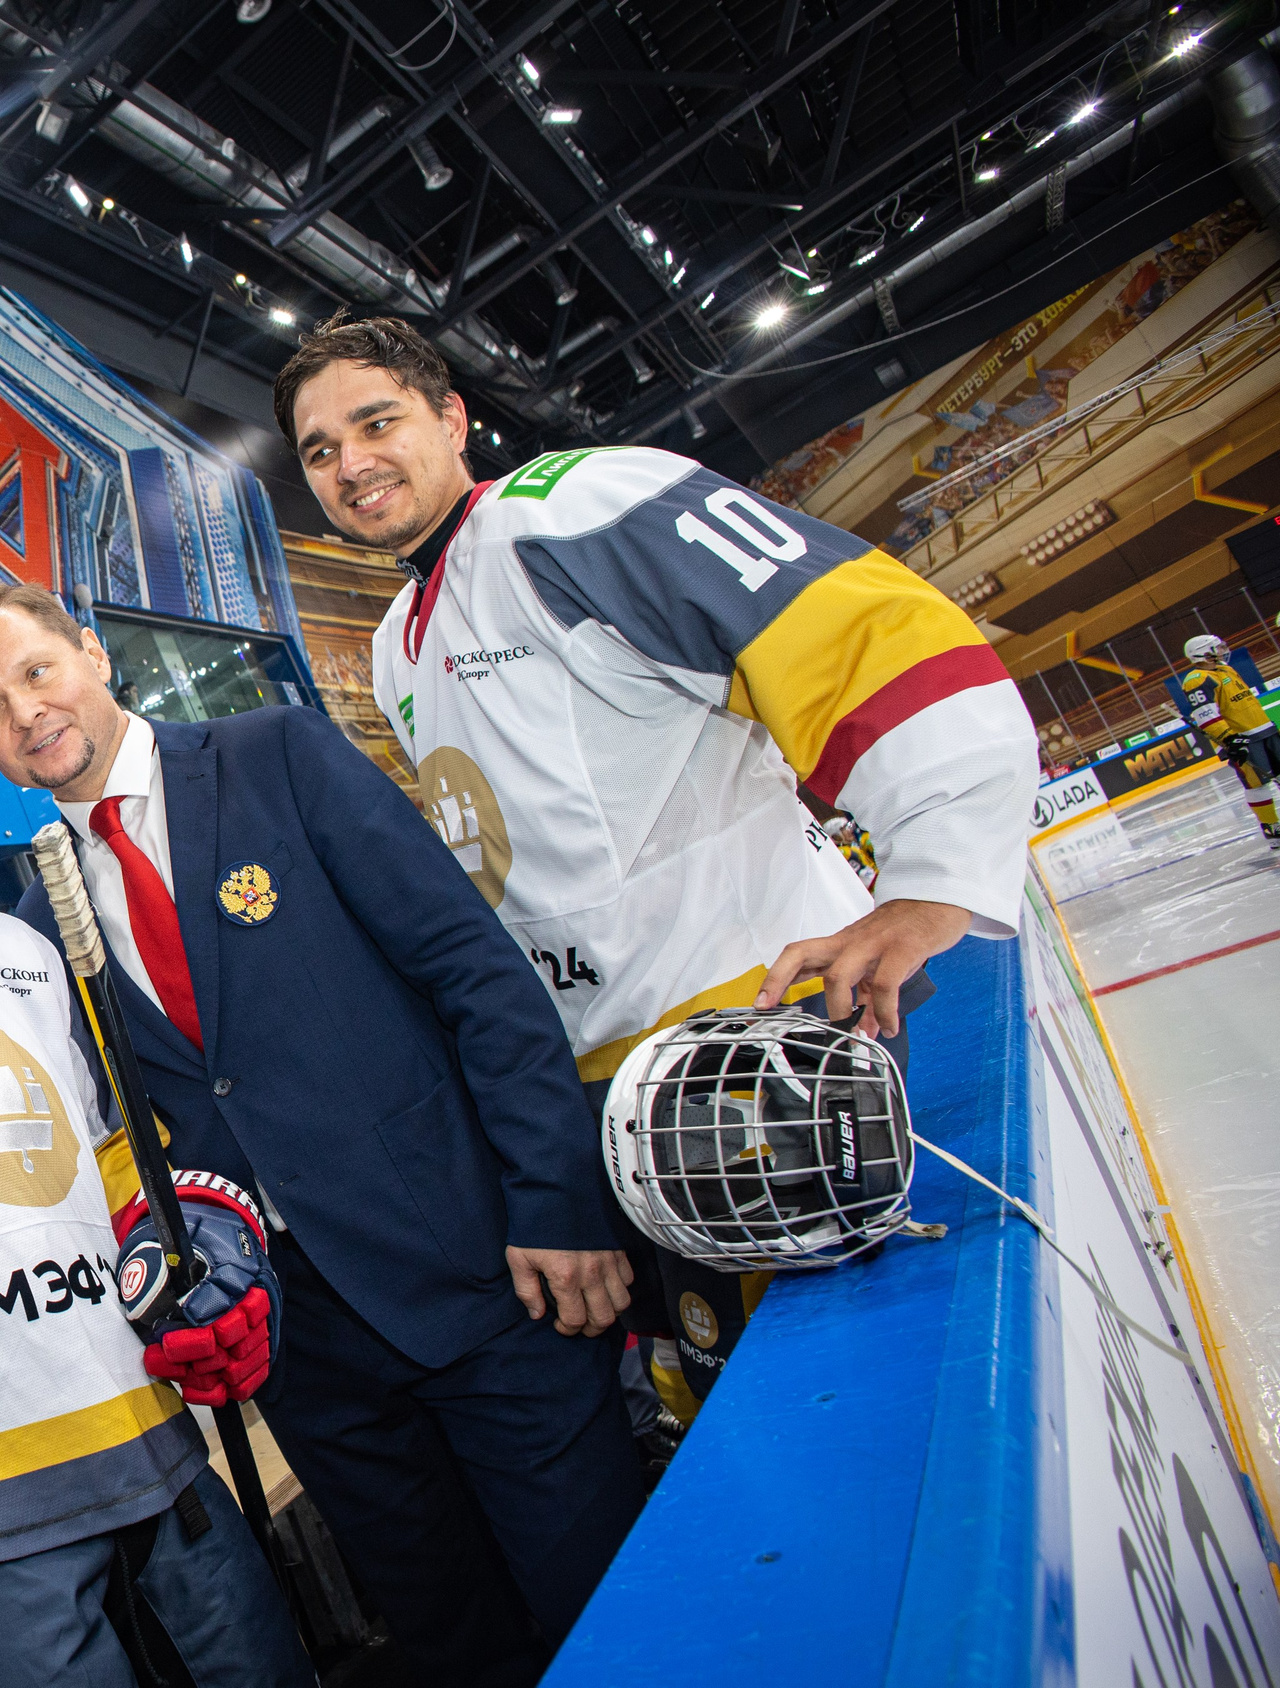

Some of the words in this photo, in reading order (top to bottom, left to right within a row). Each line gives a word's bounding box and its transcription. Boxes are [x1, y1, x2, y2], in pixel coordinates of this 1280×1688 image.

[1036, 280, 1095, 328] ХОКК
[674, 487, 808, 593] 10
[1188, 689, 1207, 707] 96
[1124, 732, 1203, 782] МАТЧ!
[1052, 780, 1099, 811] LADA
[608, 1114, 625, 1194] BAUER
[837, 1110, 857, 1180] BAUER
